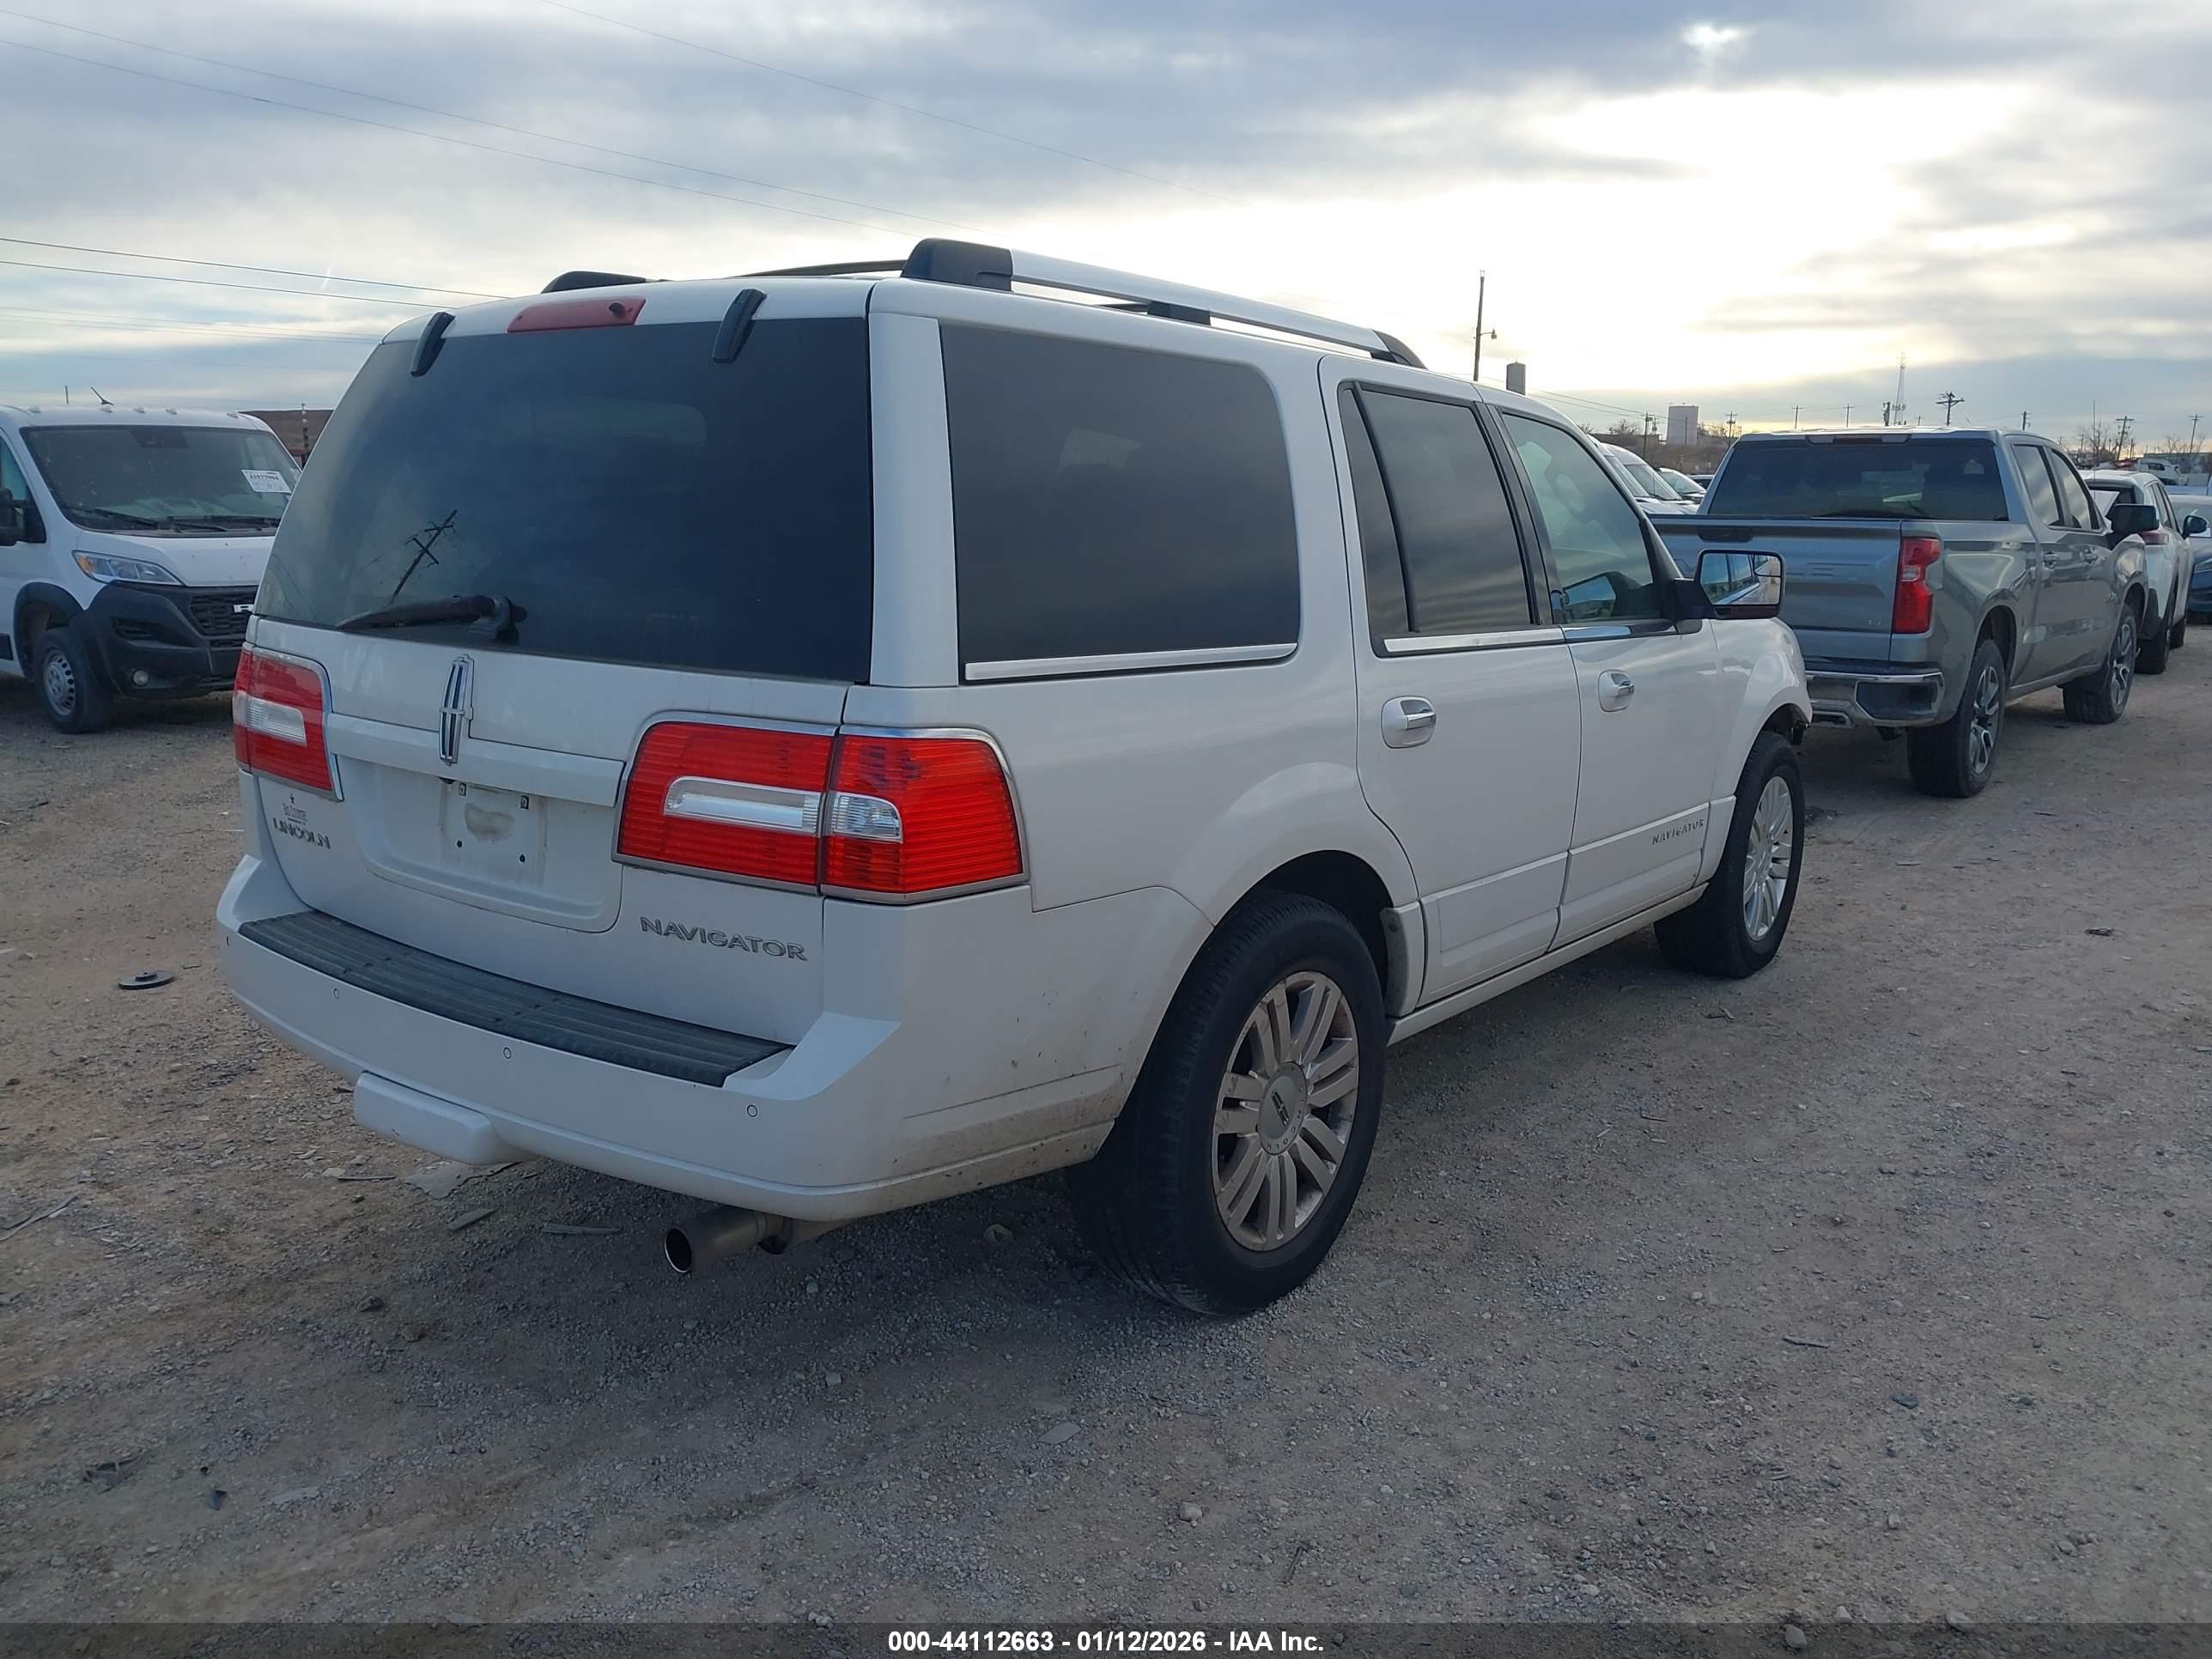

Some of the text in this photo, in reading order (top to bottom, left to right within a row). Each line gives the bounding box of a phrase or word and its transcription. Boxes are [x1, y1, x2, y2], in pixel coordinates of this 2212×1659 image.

[274, 817, 331, 849] LINCOLN
[1650, 818, 1705, 845] NAVIGATOR
[640, 915, 808, 962] NAVIGATOR
